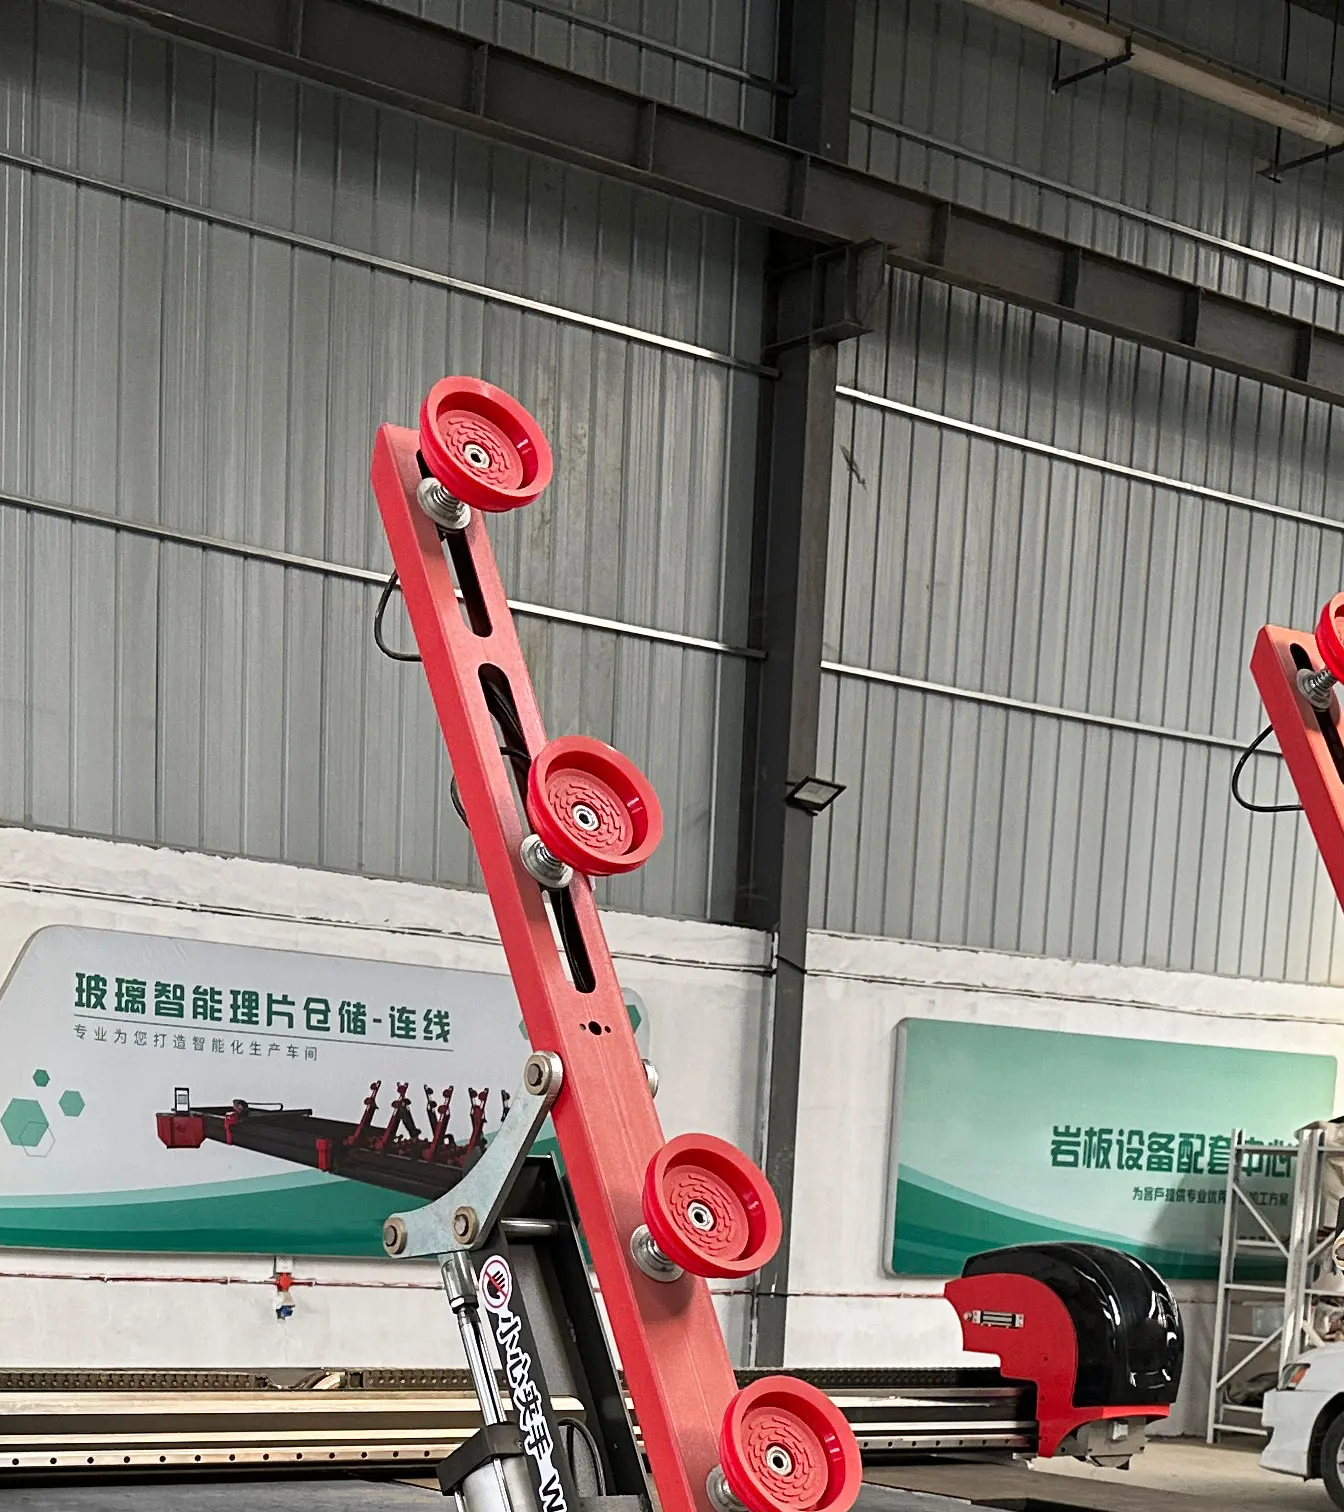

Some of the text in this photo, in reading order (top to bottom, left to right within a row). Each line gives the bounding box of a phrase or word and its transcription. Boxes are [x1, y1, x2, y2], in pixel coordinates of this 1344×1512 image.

[73, 1023, 318, 1061] 专业为您打造智能化生产车间
[74, 972, 450, 1043] 玻璃智能理片仓储-连线
[499, 1316, 551, 1460] 小心夹手
